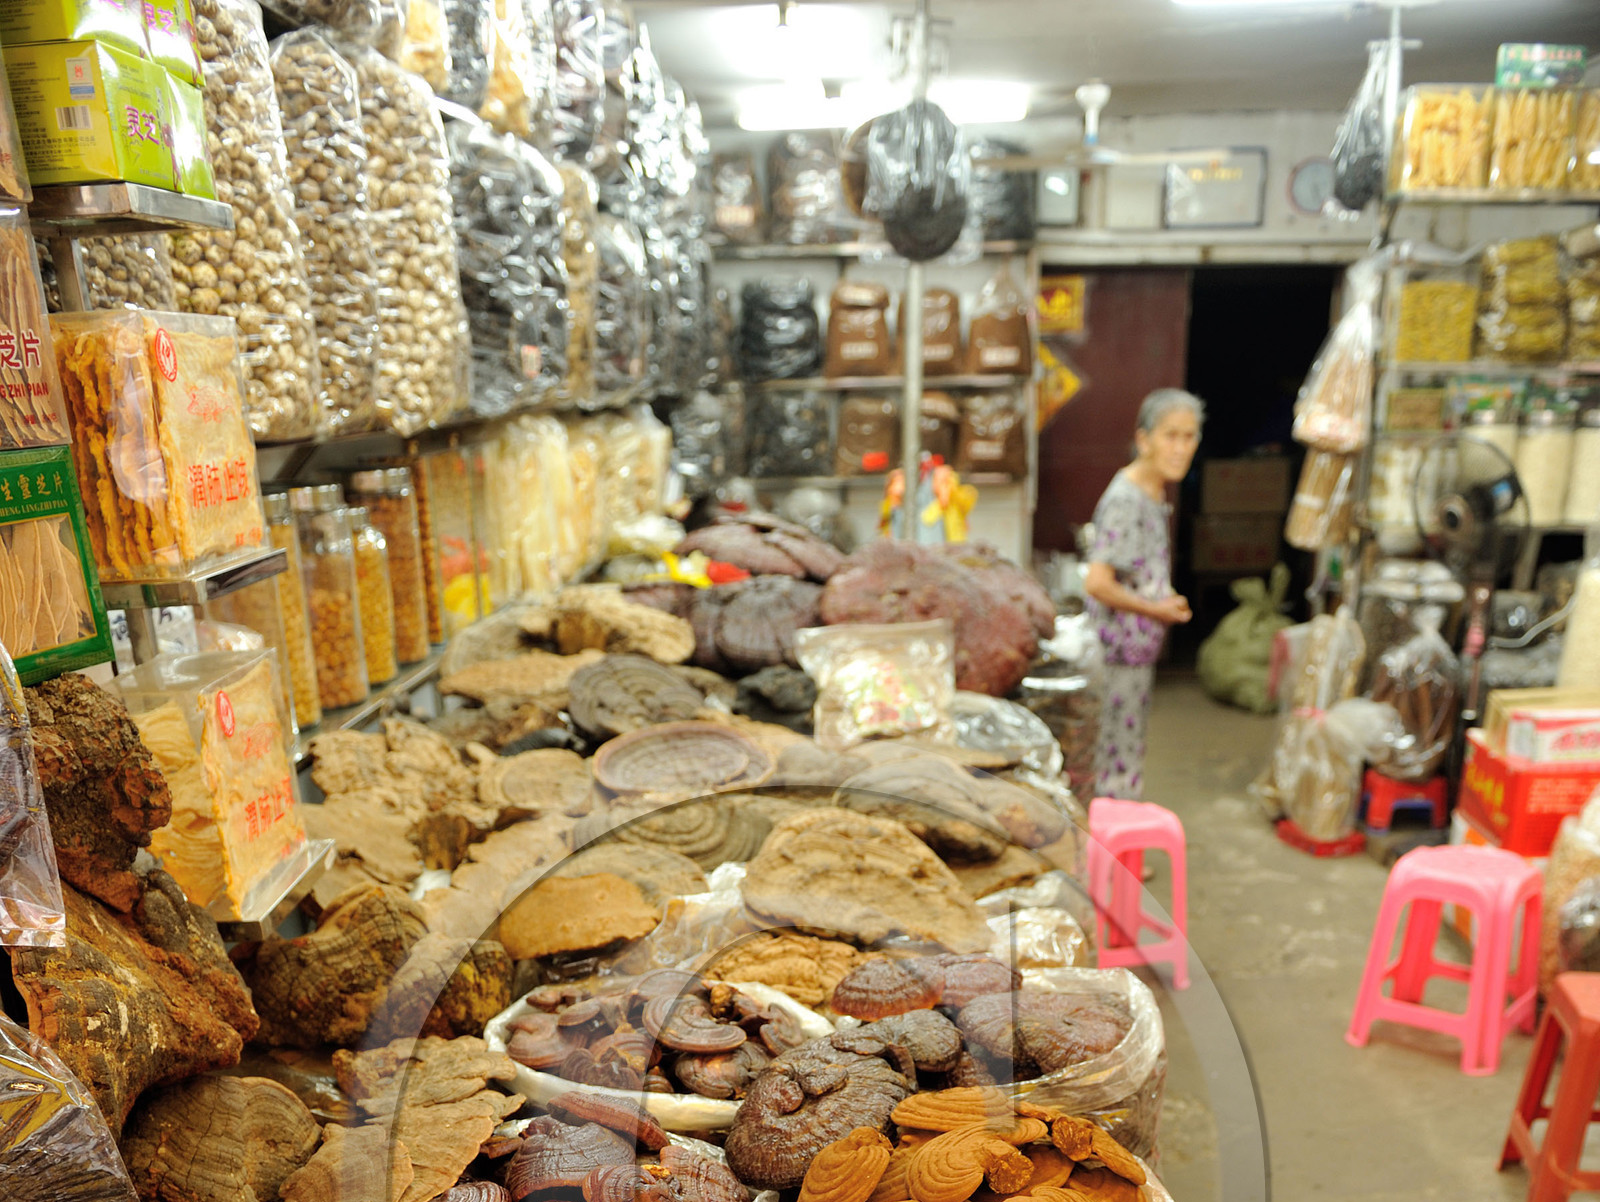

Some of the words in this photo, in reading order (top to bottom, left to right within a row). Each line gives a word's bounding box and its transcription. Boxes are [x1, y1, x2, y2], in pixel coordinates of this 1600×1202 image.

[125, 104, 160, 146] 灵芝
[8, 383, 26, 398] ZHI
[27, 382, 49, 397] PIAN
